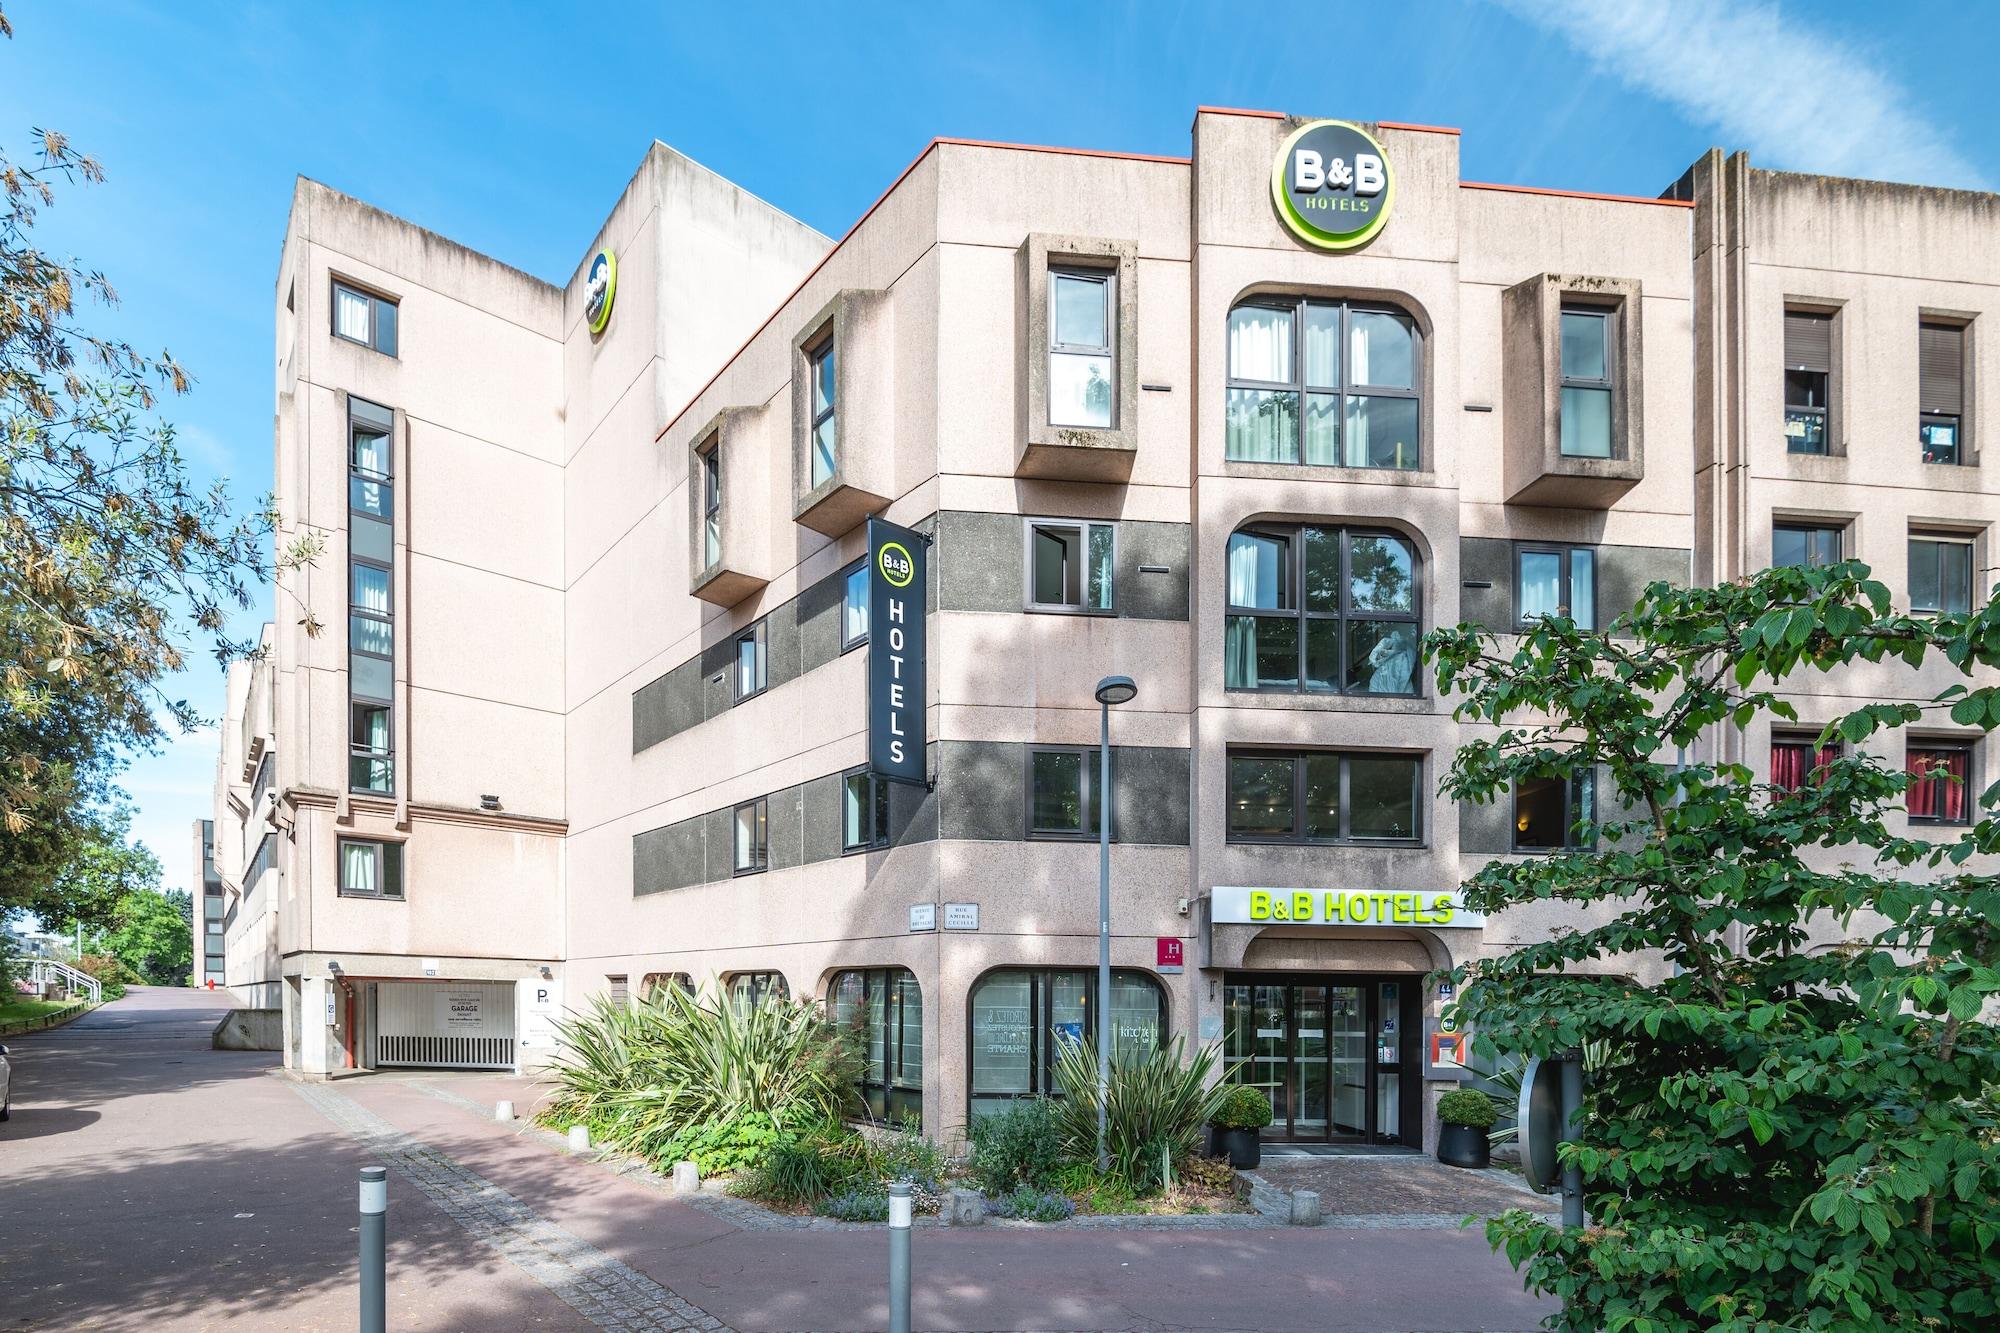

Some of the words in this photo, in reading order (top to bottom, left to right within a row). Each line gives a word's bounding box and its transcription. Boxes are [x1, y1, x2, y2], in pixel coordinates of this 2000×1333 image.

[1295, 149, 1385, 197] B&B
[1305, 197, 1370, 213] HOTELS
[883, 553, 909, 574] B&B
[887, 568, 906, 579] HOTELS
[889, 598, 905, 764] HOTELS
[1250, 891, 1314, 921] B&B
[1324, 892, 1454, 924] HOTELS
[1168, 943, 1180, 954] H
[537, 989, 548, 1003] P
